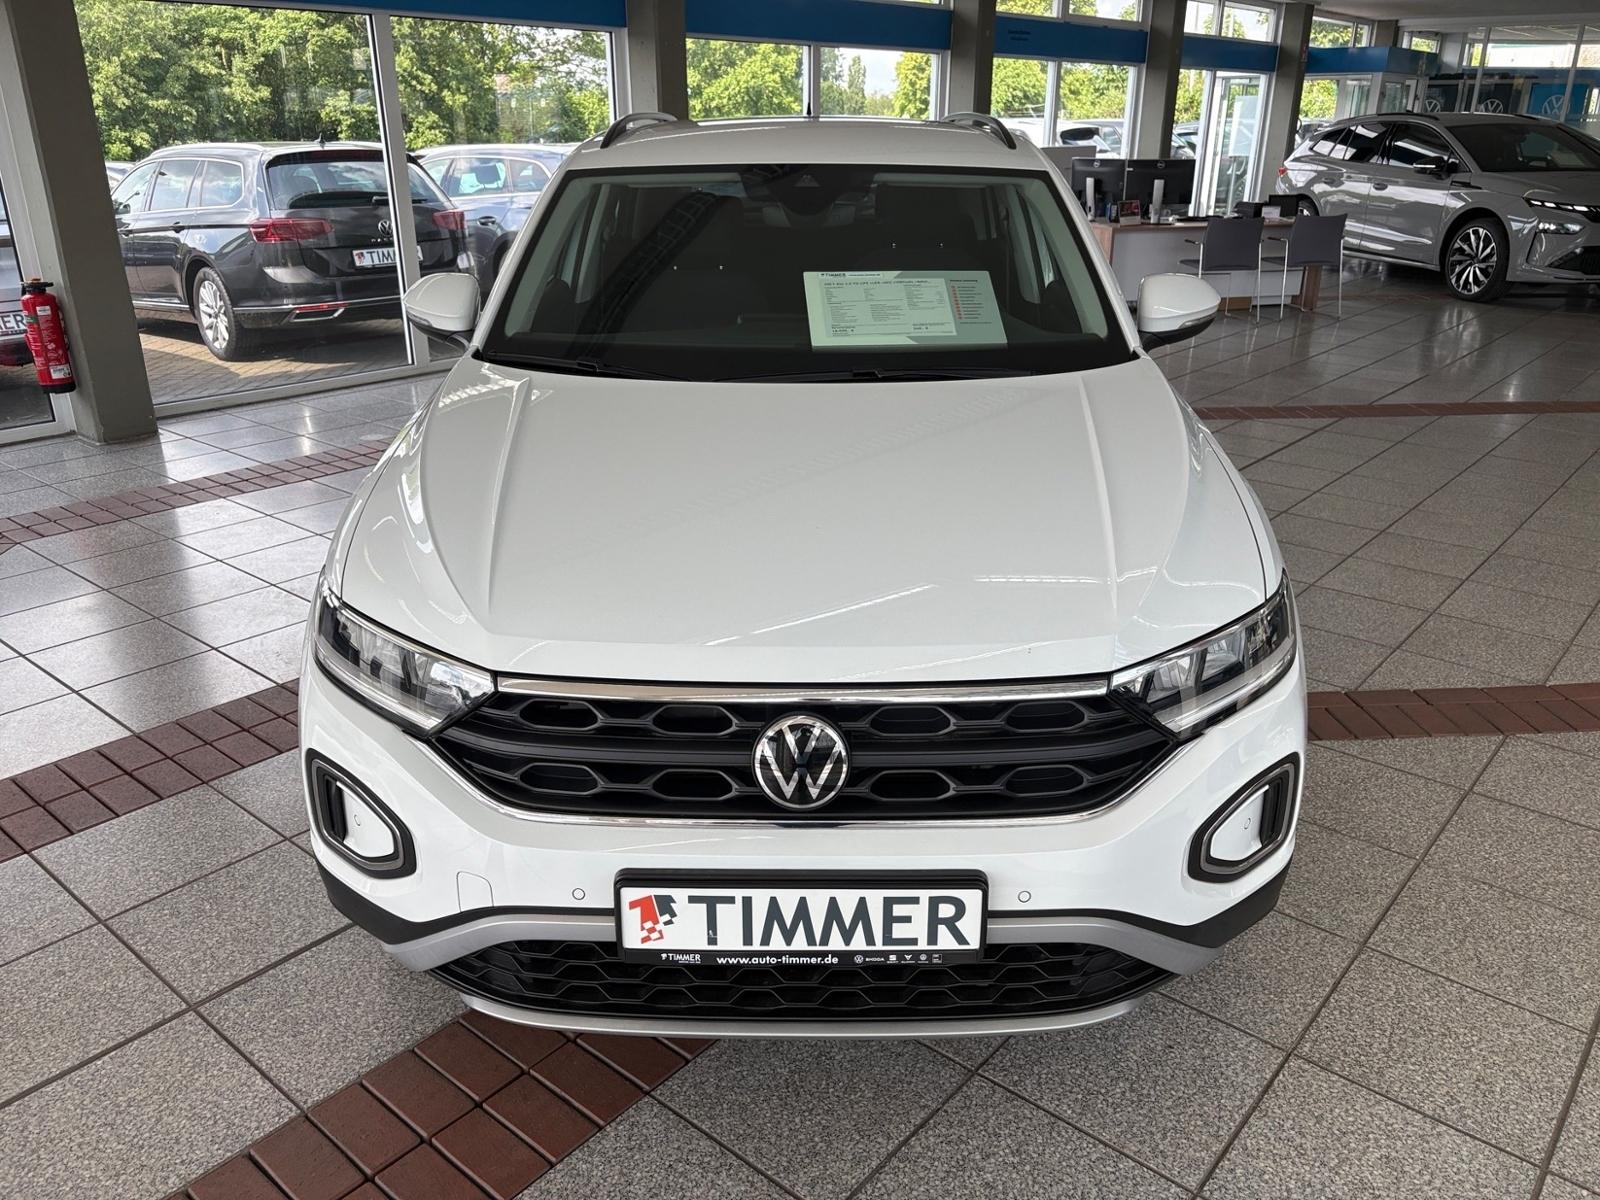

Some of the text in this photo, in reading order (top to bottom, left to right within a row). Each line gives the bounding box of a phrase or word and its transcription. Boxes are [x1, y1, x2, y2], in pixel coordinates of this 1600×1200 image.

[366, 248, 397, 265] TIM
[687, 894, 971, 947] TIMMER
[668, 953, 701, 961] TIMMER
[716, 953, 839, 965] www.auto-timmer.de
